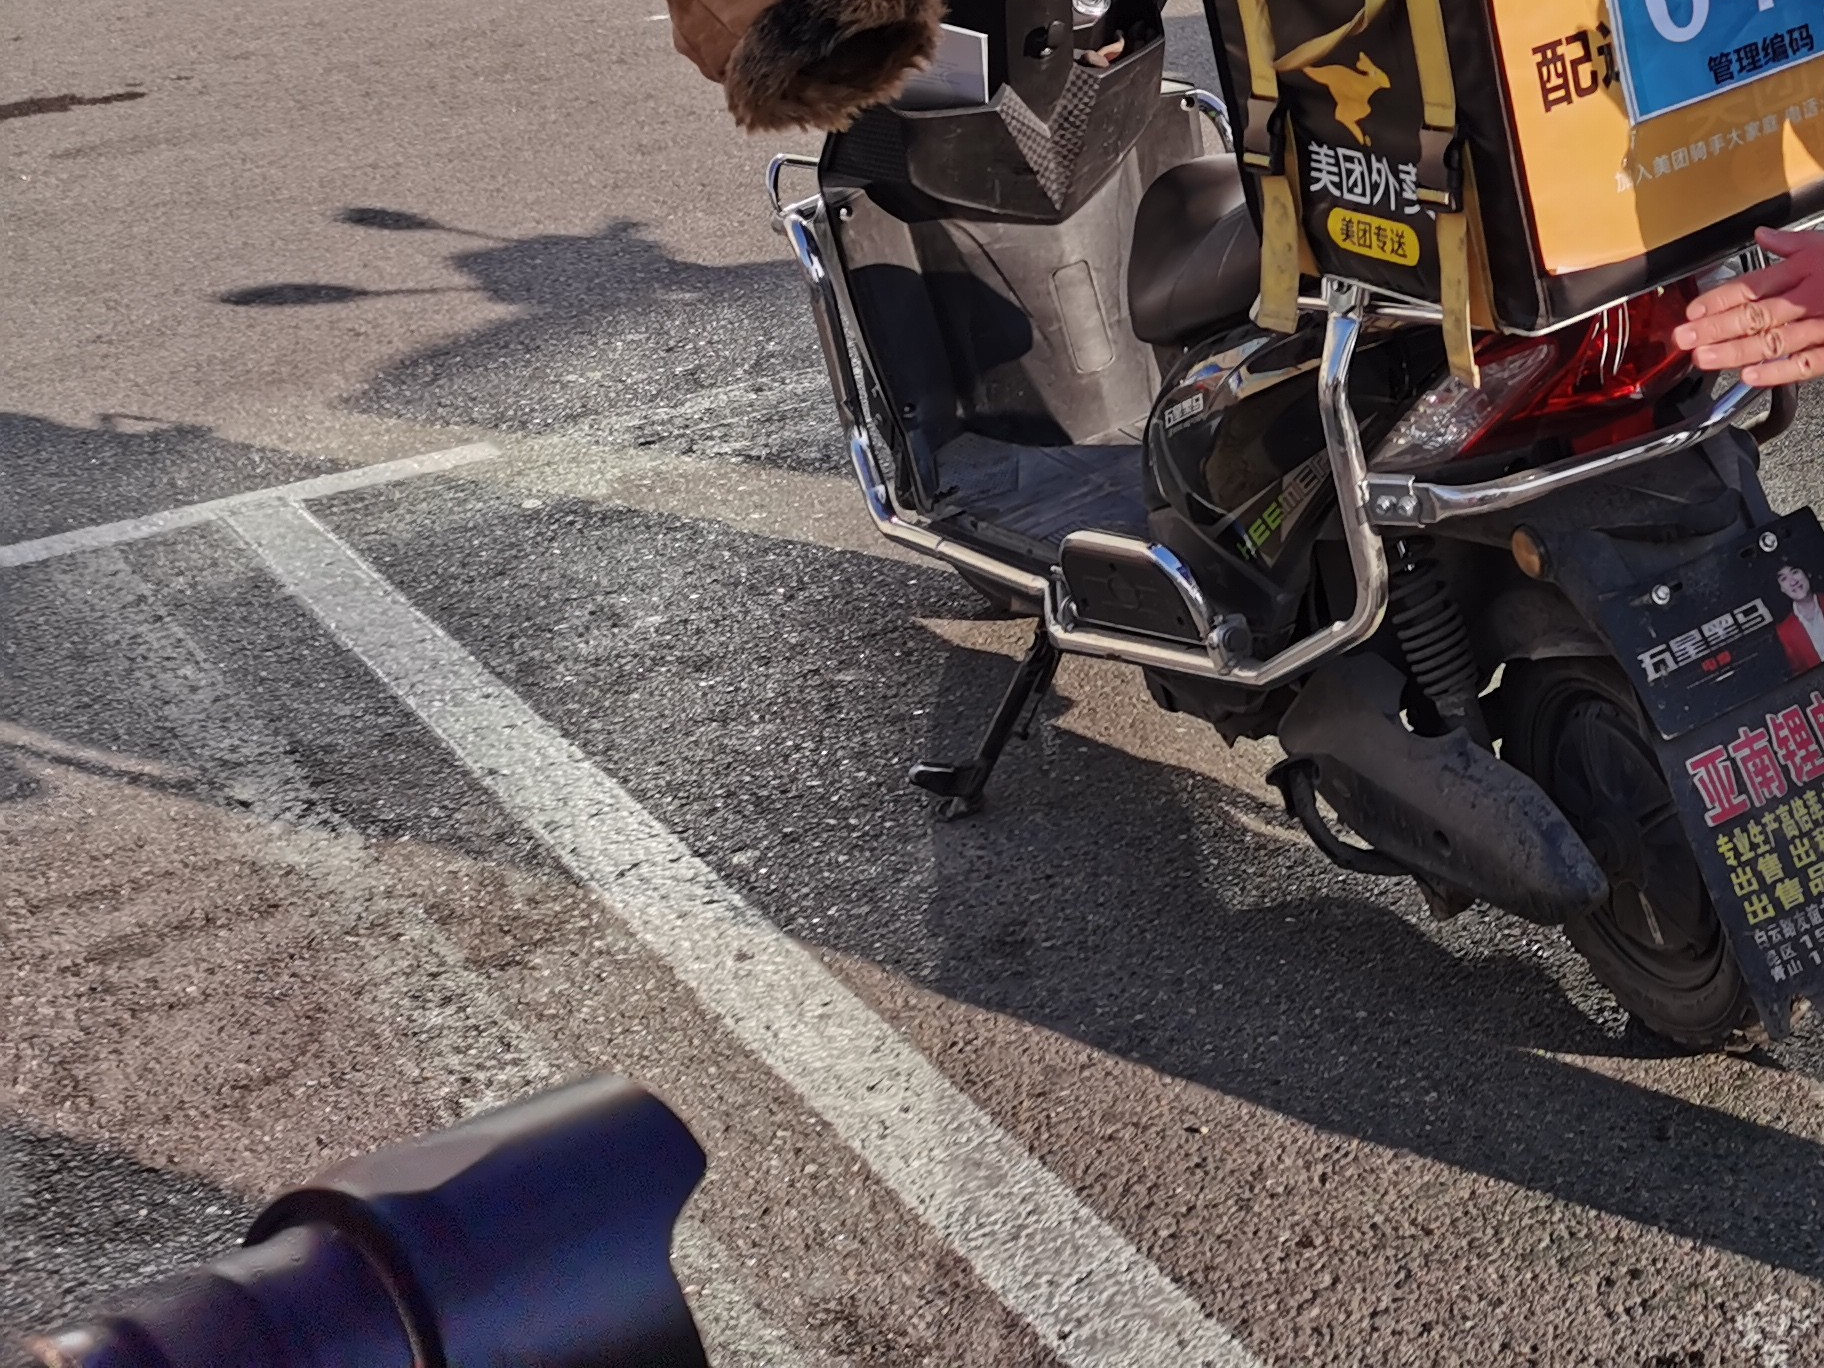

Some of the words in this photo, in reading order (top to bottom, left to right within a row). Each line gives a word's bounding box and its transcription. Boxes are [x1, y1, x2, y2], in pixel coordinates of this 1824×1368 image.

[1708, 24, 1816, 86] 管理编码
[1339, 216, 1409, 259] 美团专送
[1729, 851, 1785, 897] 出售
